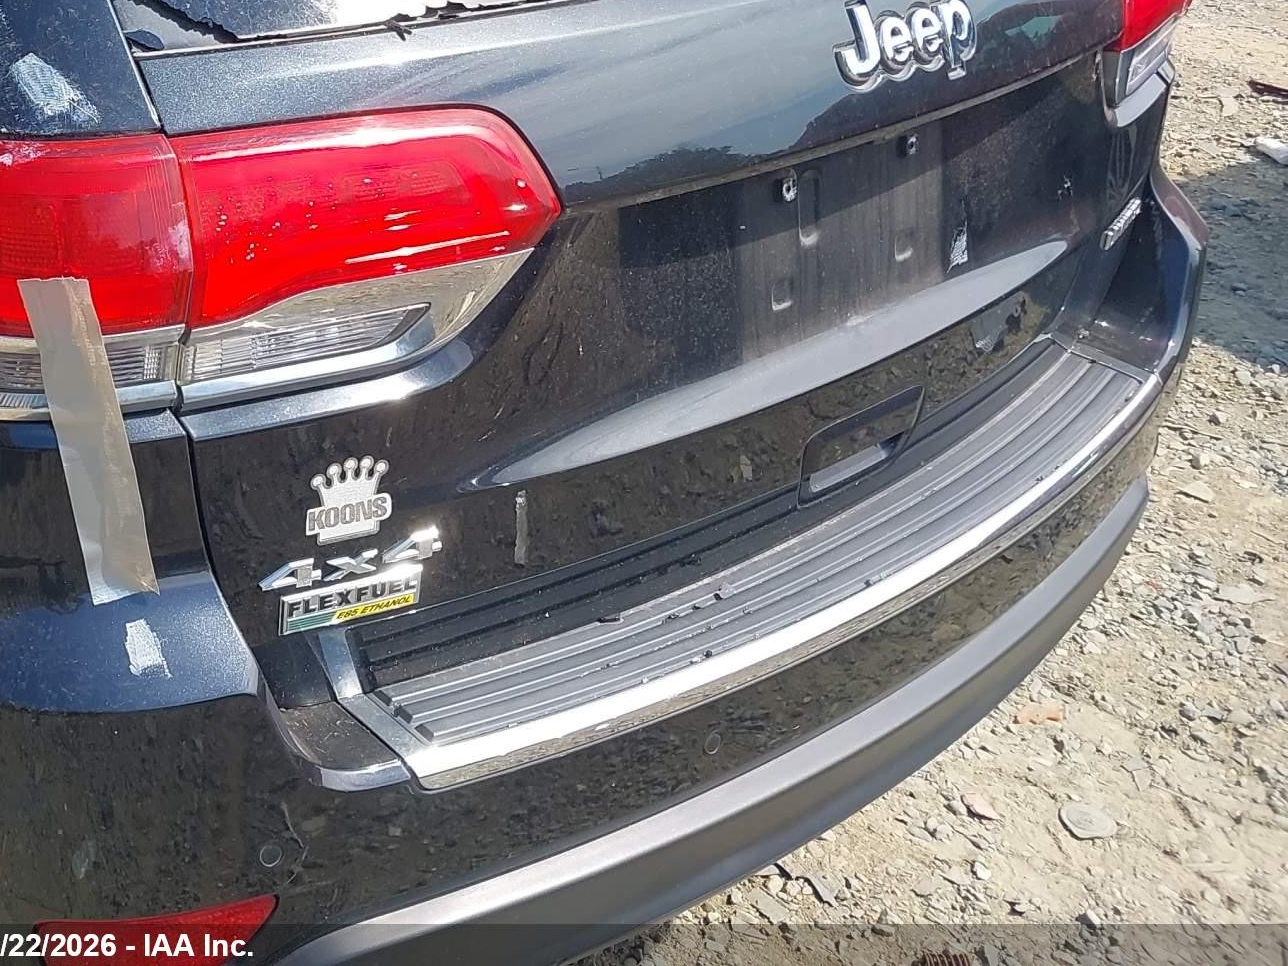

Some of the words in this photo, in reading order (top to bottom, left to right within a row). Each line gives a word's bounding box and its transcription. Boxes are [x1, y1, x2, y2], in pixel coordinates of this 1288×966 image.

[308, 496, 388, 532] KOONS
[335, 606, 360, 620] E85
[360, 594, 413, 615] ETHANOL
